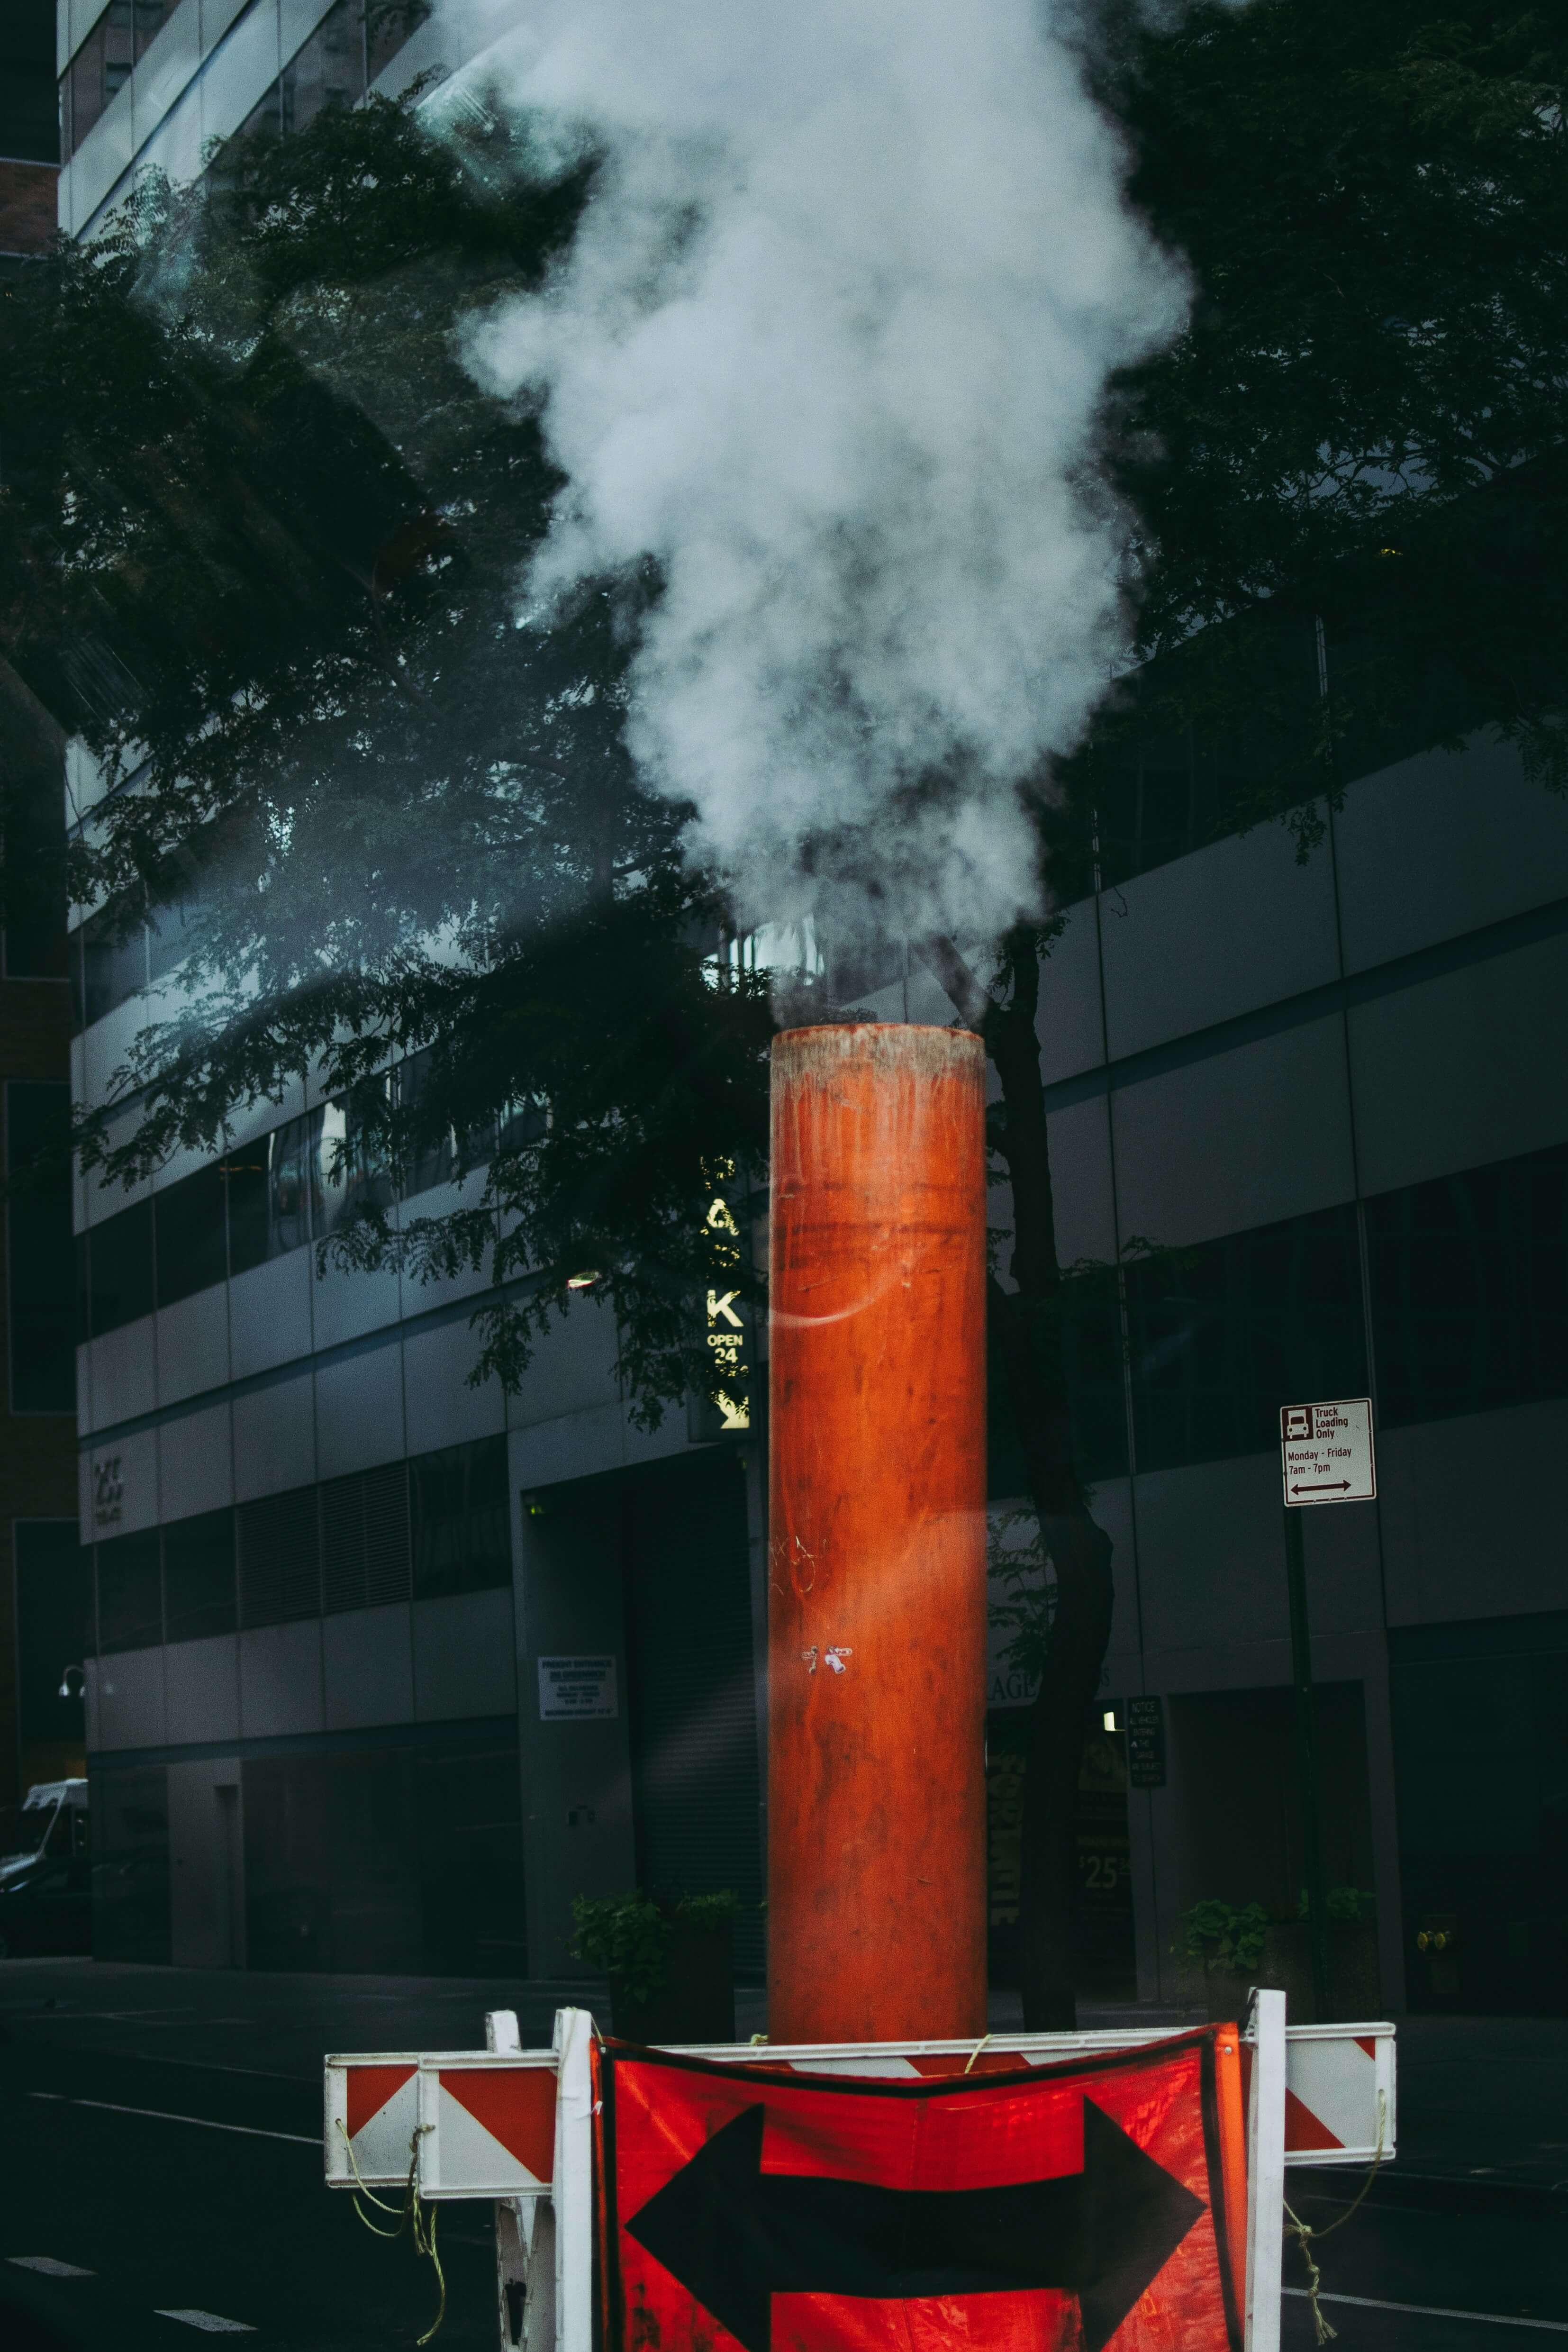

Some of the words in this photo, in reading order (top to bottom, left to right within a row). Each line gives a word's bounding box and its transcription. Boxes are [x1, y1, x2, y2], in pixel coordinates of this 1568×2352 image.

[707, 1334, 743, 1347] OPEN
[714, 1347, 739, 1364] 24
[1314, 1407, 1338, 1418] Truck
[1315, 1417, 1348, 1428] Loading
[1316, 1429, 1335, 1439] Only
[1288, 1451, 1319, 1461] Monday
[1327, 1447, 1352, 1458] Friday
[1288, 1466, 1305, 1475] 7am
[1313, 1463, 1330, 1474] 7pm
[986, 1673, 1036, 1701] AGE
[1132, 1701, 1156, 1713] NOTICE
[1133, 1727, 1155, 1736] ENTERING
